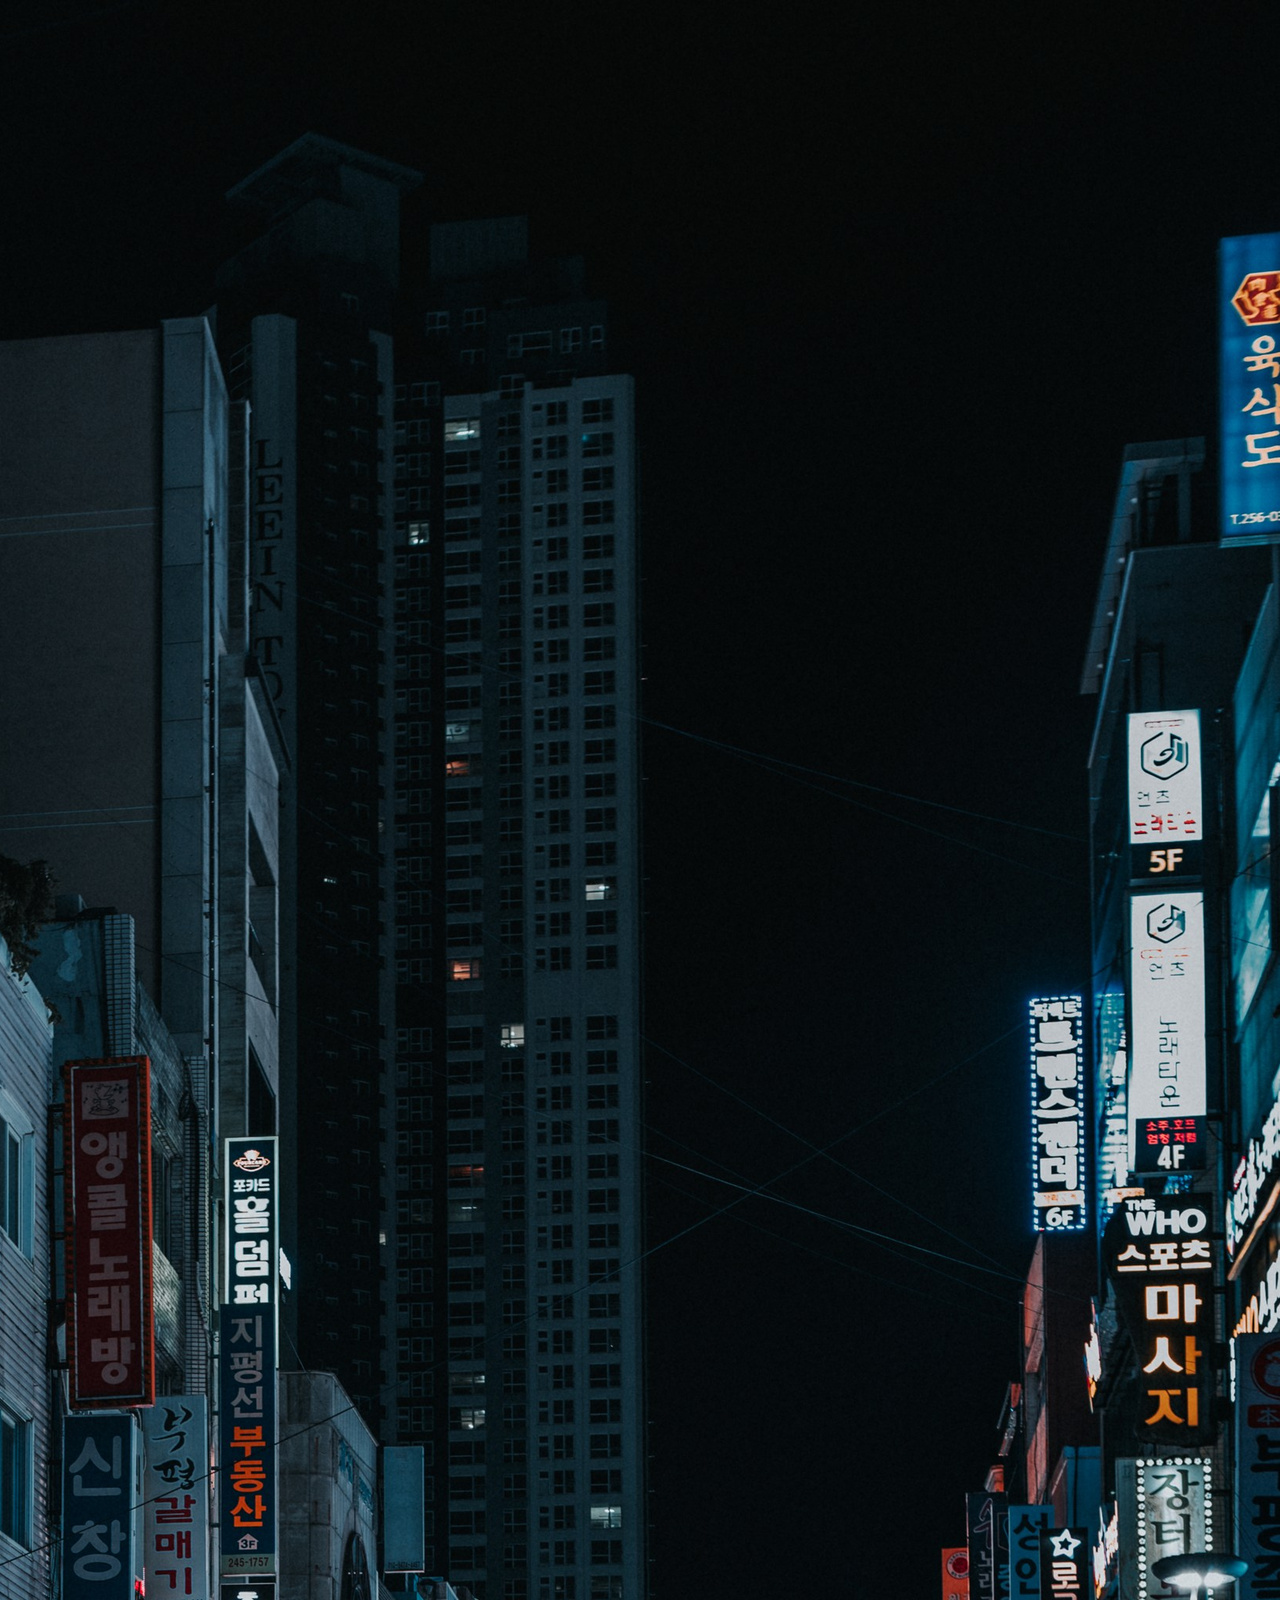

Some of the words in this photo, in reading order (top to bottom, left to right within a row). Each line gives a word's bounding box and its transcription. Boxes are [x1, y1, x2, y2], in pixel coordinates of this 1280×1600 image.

[1149, 848, 1183, 872] 5F
[1157, 1145, 1185, 1170] 4F
[233, 1178, 270, 1193] 포카드
[1046, 1208, 1074, 1226] 6F
[1124, 1199, 1156, 1212] THE
[1126, 1208, 1206, 1236] WHO
[80, 1131, 136, 1385] 앵콜노래방
[1117, 1240, 1212, 1272] 스포츠
[230, 1315, 264, 1419] 지평선
[1144, 1284, 1203, 1427] 마사지
[229, 1425, 266, 1528] 부동산
[240, 1537, 258, 1549] 3F
[227, 1556, 269, 1569] 245-1757
